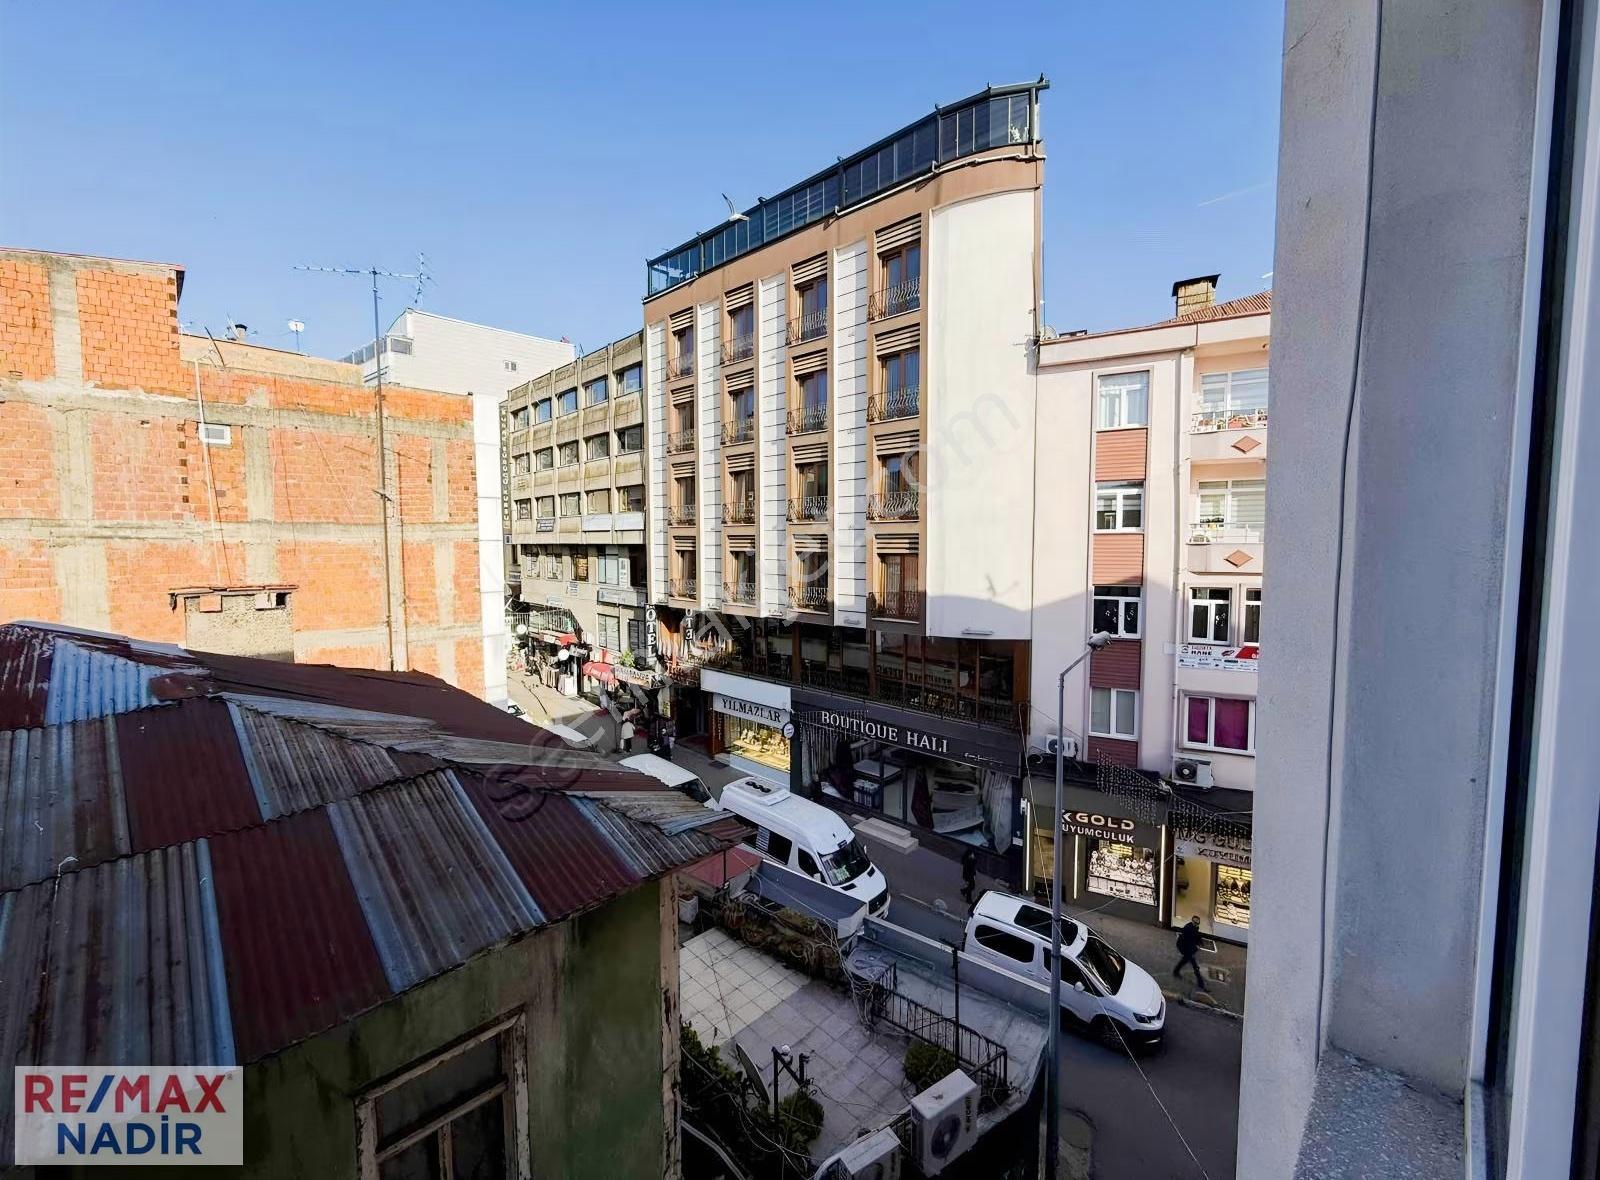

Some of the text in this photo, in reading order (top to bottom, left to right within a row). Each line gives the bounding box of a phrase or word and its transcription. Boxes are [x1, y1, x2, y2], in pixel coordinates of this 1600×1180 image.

[646, 605, 657, 658] OTEL
[722, 698, 781, 723] YILMAZLAR
[820, 710, 898, 742] BOUTIQUE
[906, 730, 948, 753] HALI
[1075, 812, 1135, 830] GOLD
[1062, 824, 1135, 844] UYUMCULUK
